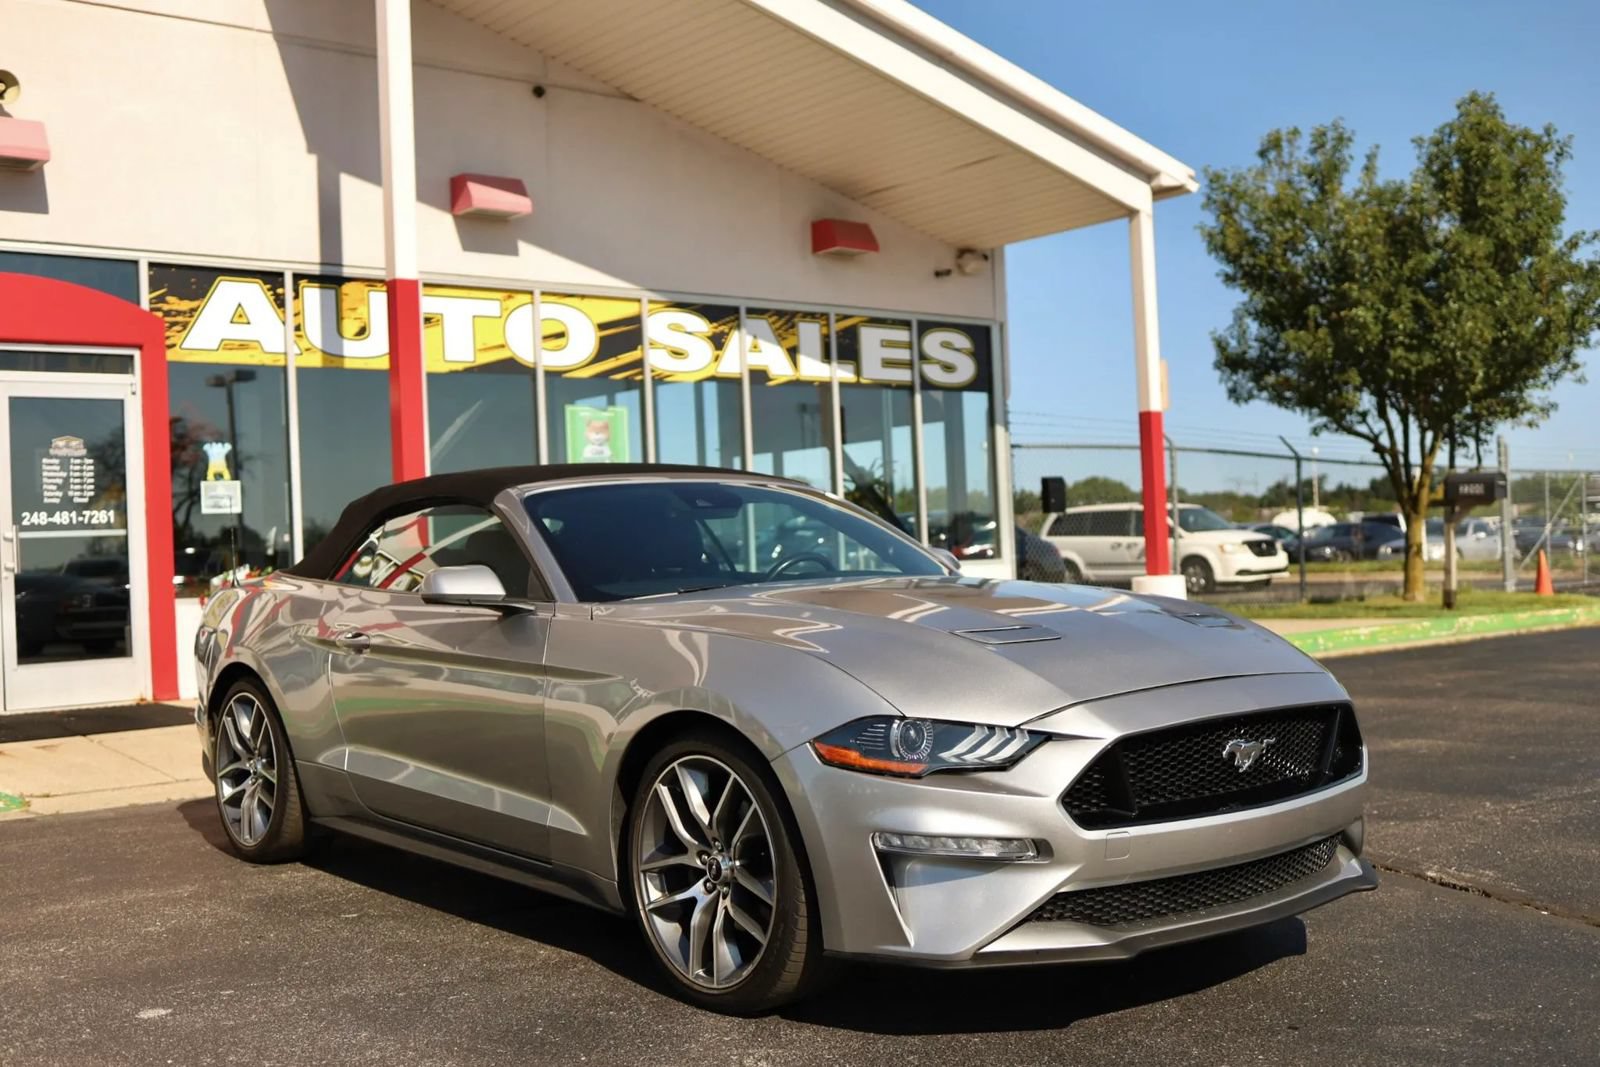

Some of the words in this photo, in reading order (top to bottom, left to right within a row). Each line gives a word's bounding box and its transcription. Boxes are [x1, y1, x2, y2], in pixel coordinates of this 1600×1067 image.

[179, 278, 599, 368] AUTO
[645, 308, 977, 388] SALES
[21, 509, 115, 526] 248-481-7261
